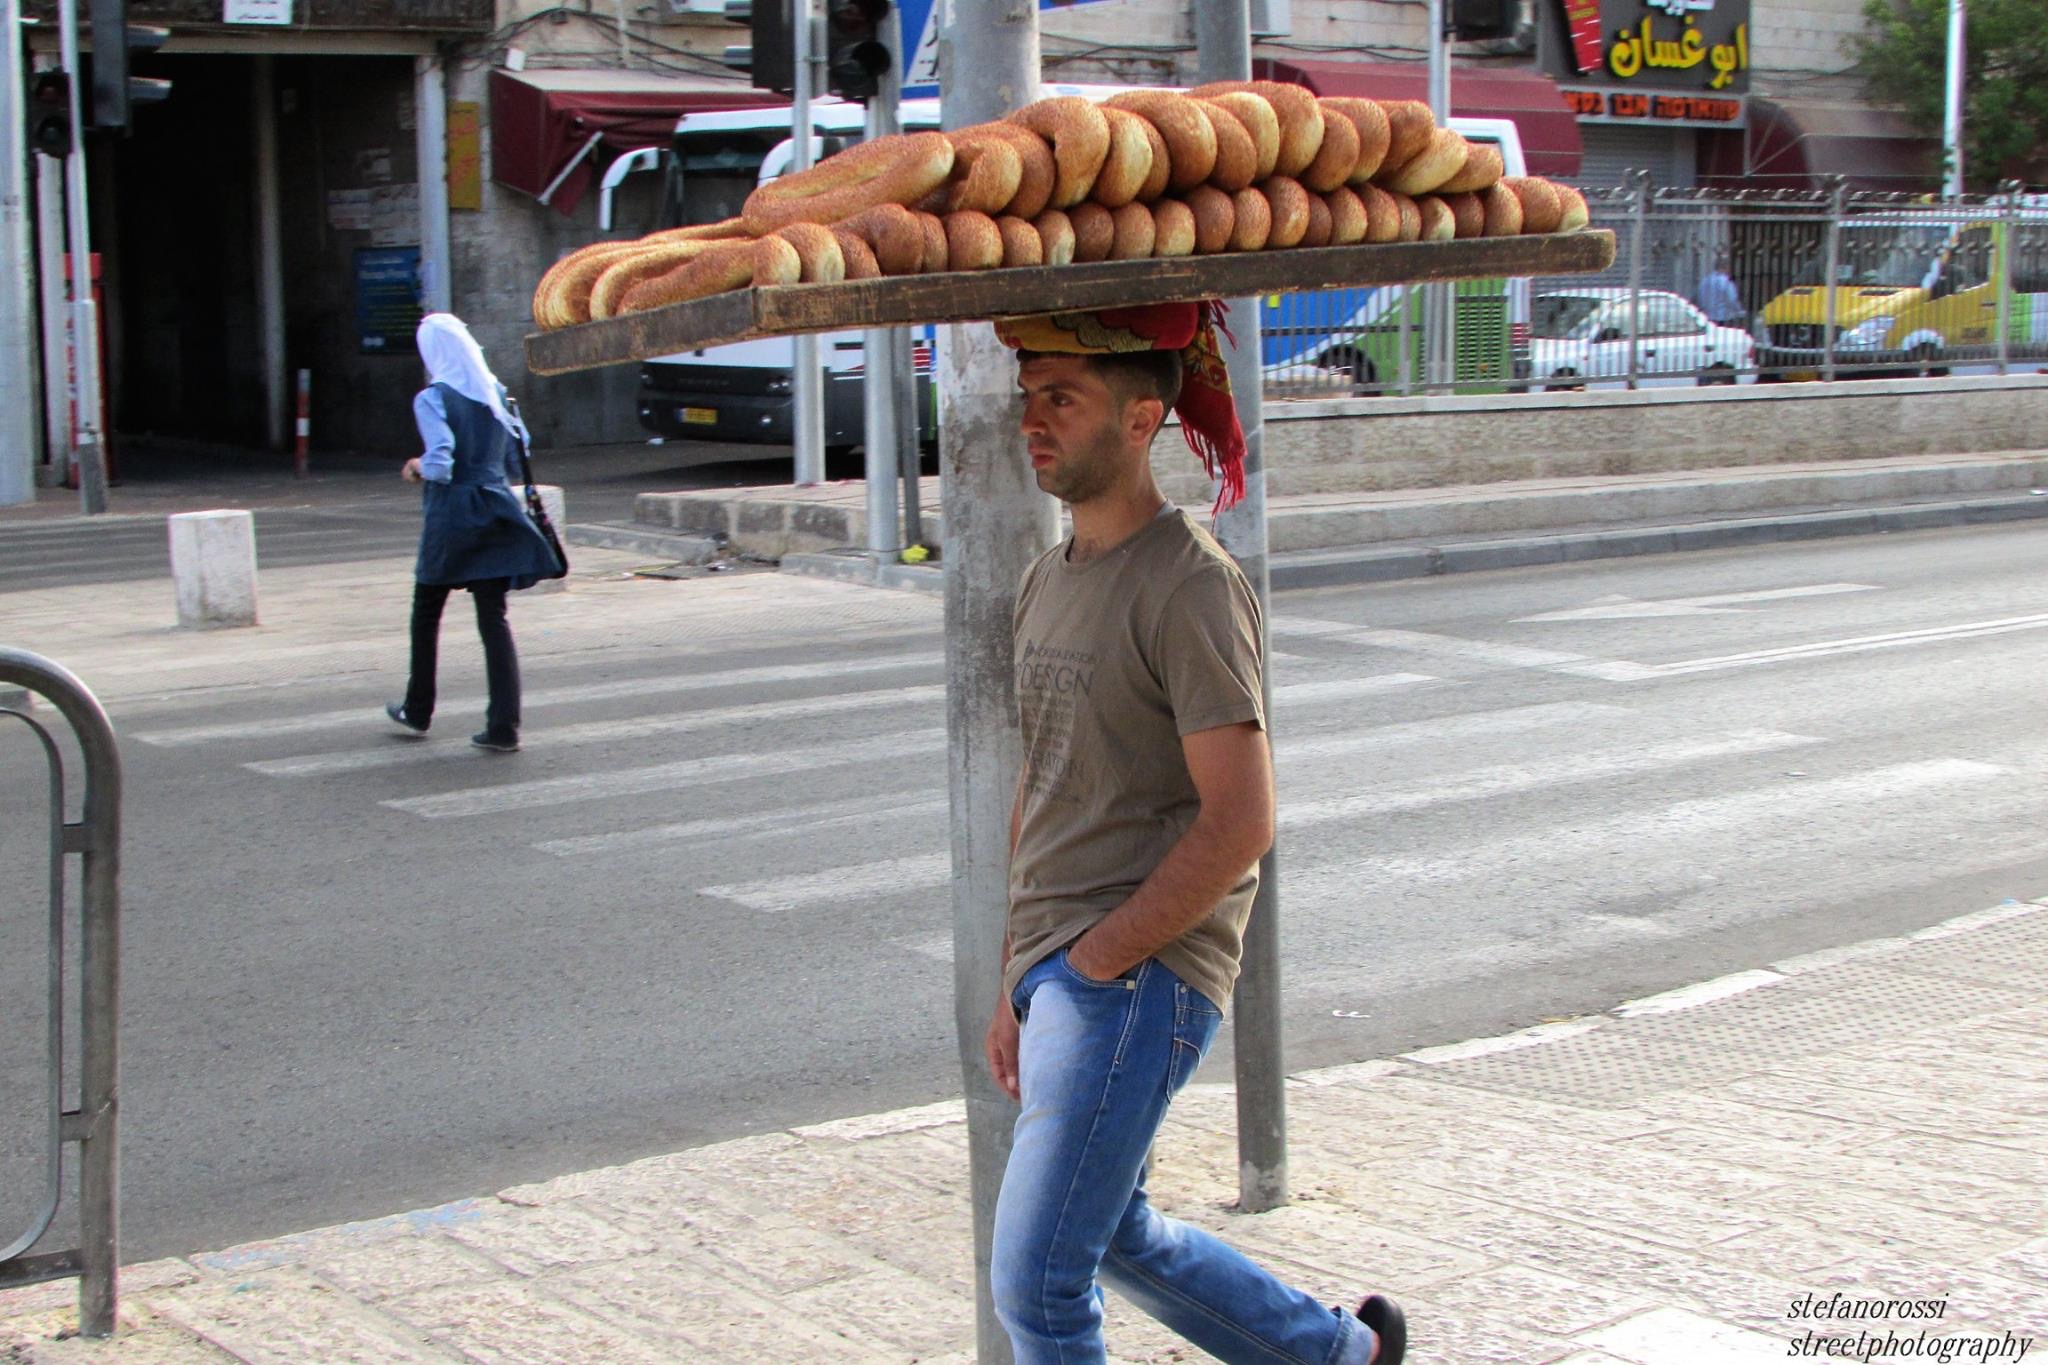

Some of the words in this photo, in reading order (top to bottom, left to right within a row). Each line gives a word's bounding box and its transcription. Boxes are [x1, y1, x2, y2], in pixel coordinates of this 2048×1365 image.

[1610, 15, 1706, 77] غسان
[1710, 23, 1747, 89] ابو
[1020, 662, 1094, 696] DESGN
